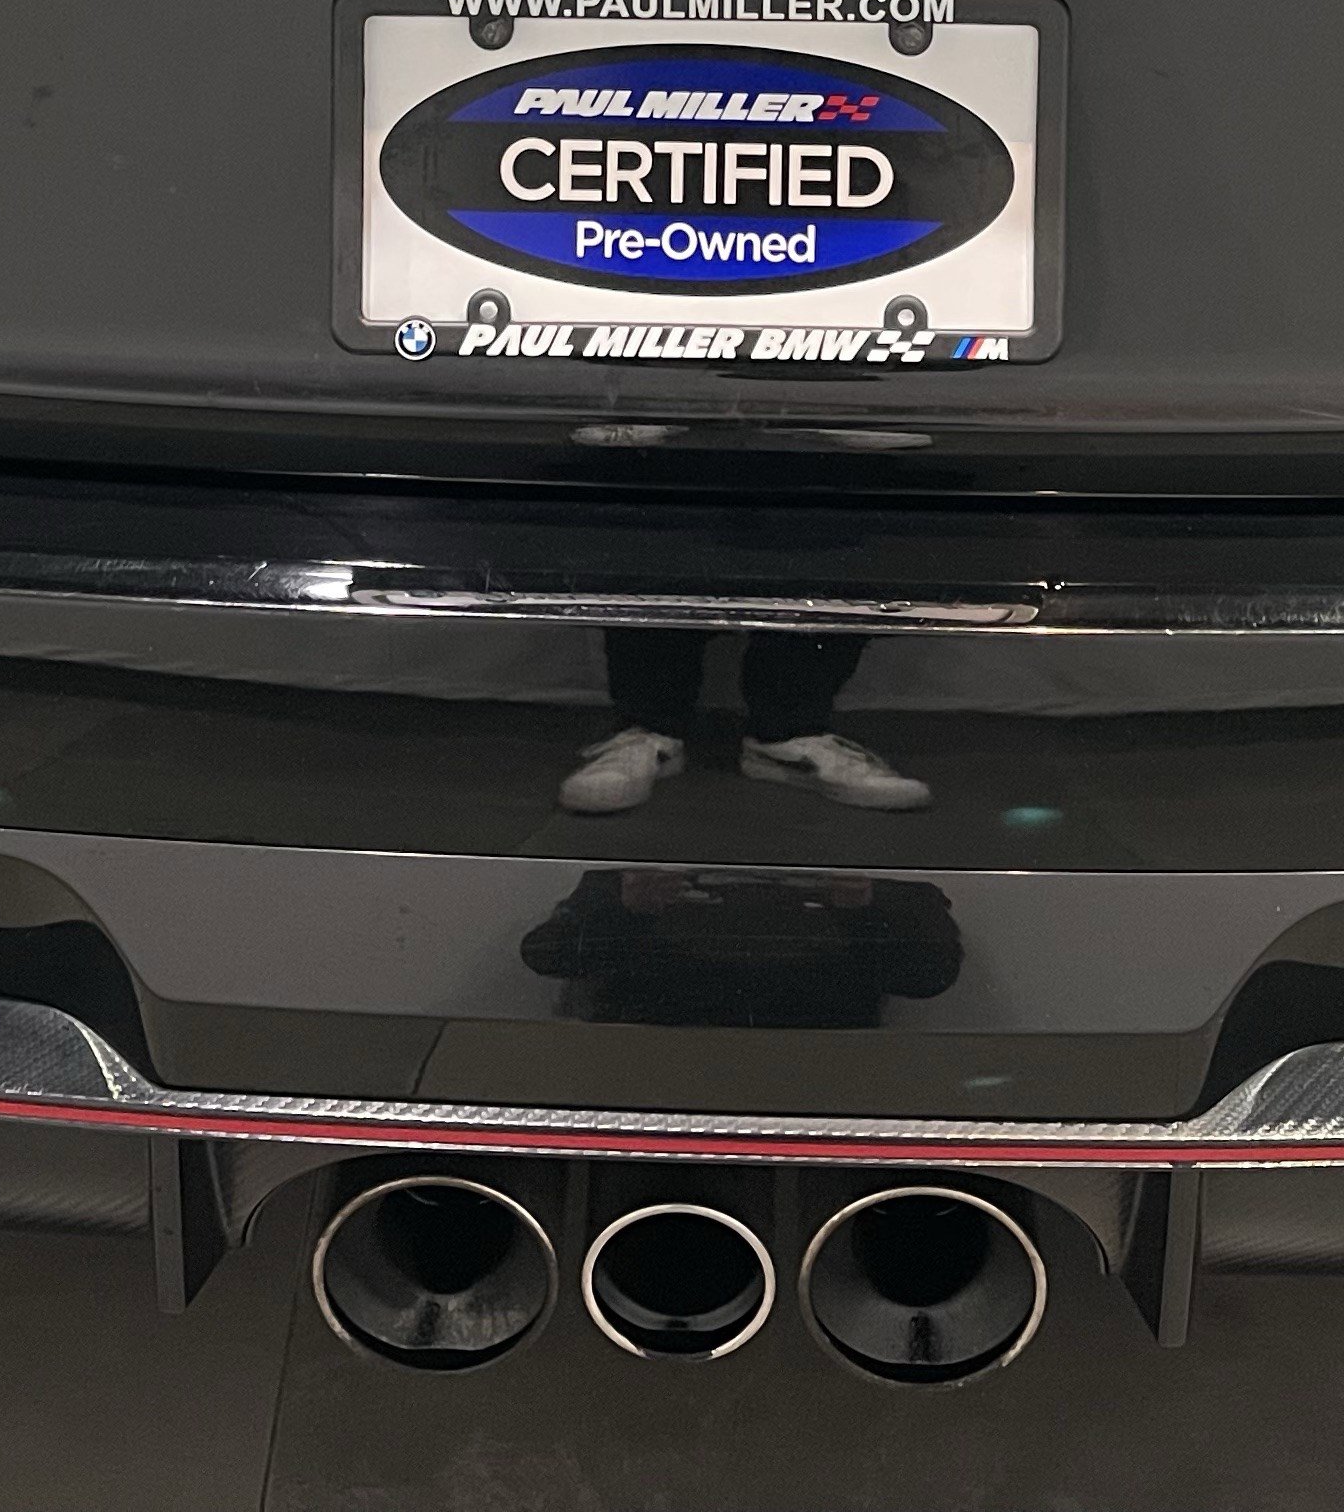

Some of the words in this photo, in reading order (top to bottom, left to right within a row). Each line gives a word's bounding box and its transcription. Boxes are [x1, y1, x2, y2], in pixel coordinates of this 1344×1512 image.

[514, 88, 634, 117] PAUL
[635, 92, 825, 123] MILLER
[499, 137, 895, 209] CERTIFIED
[575, 219, 816, 264] Pre-Owned
[458, 324, 575, 358] PAUL
[582, 325, 745, 359] MILLER
[750, 328, 872, 362] BMW
